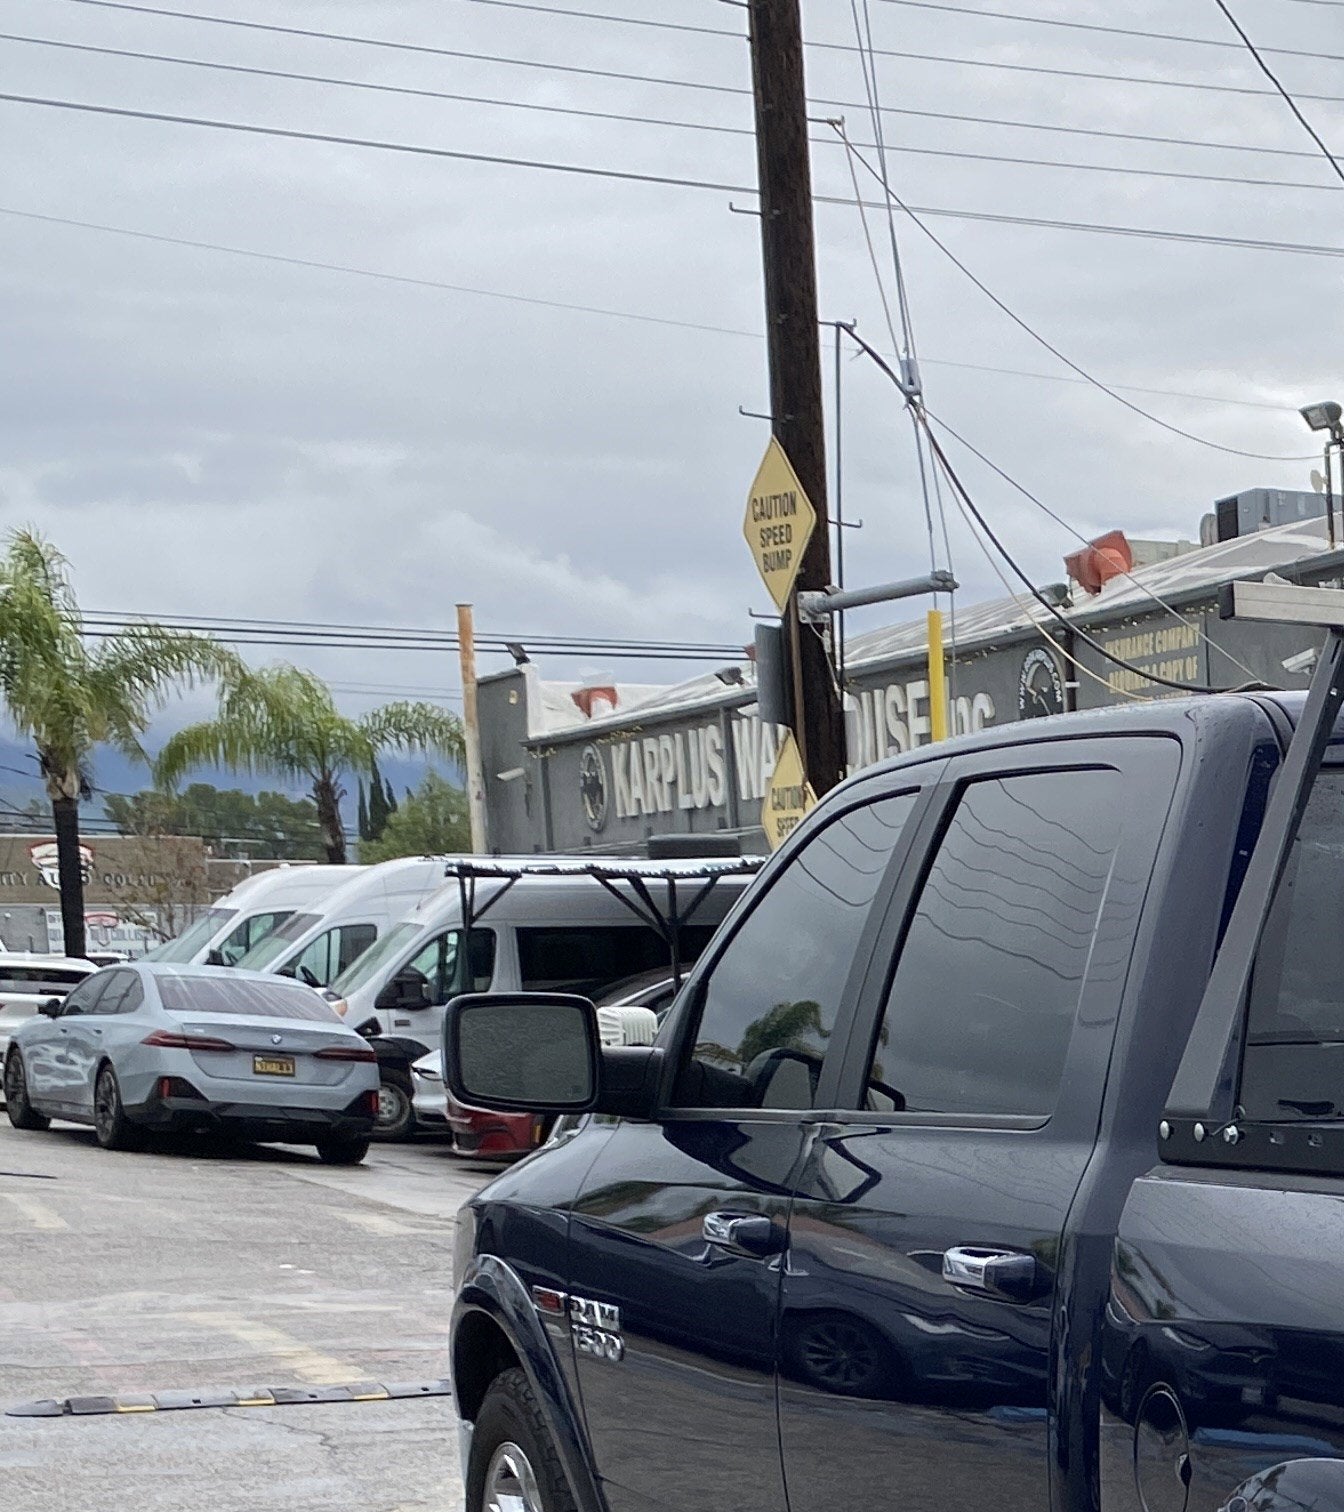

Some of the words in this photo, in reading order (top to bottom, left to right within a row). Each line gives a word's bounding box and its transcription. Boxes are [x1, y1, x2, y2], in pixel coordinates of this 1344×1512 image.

[752, 491, 797, 522] CAUTION
[760, 523, 792, 548] SPEED
[763, 549, 792, 573] BUMP
[611, 724, 726, 818] KARPLUS
